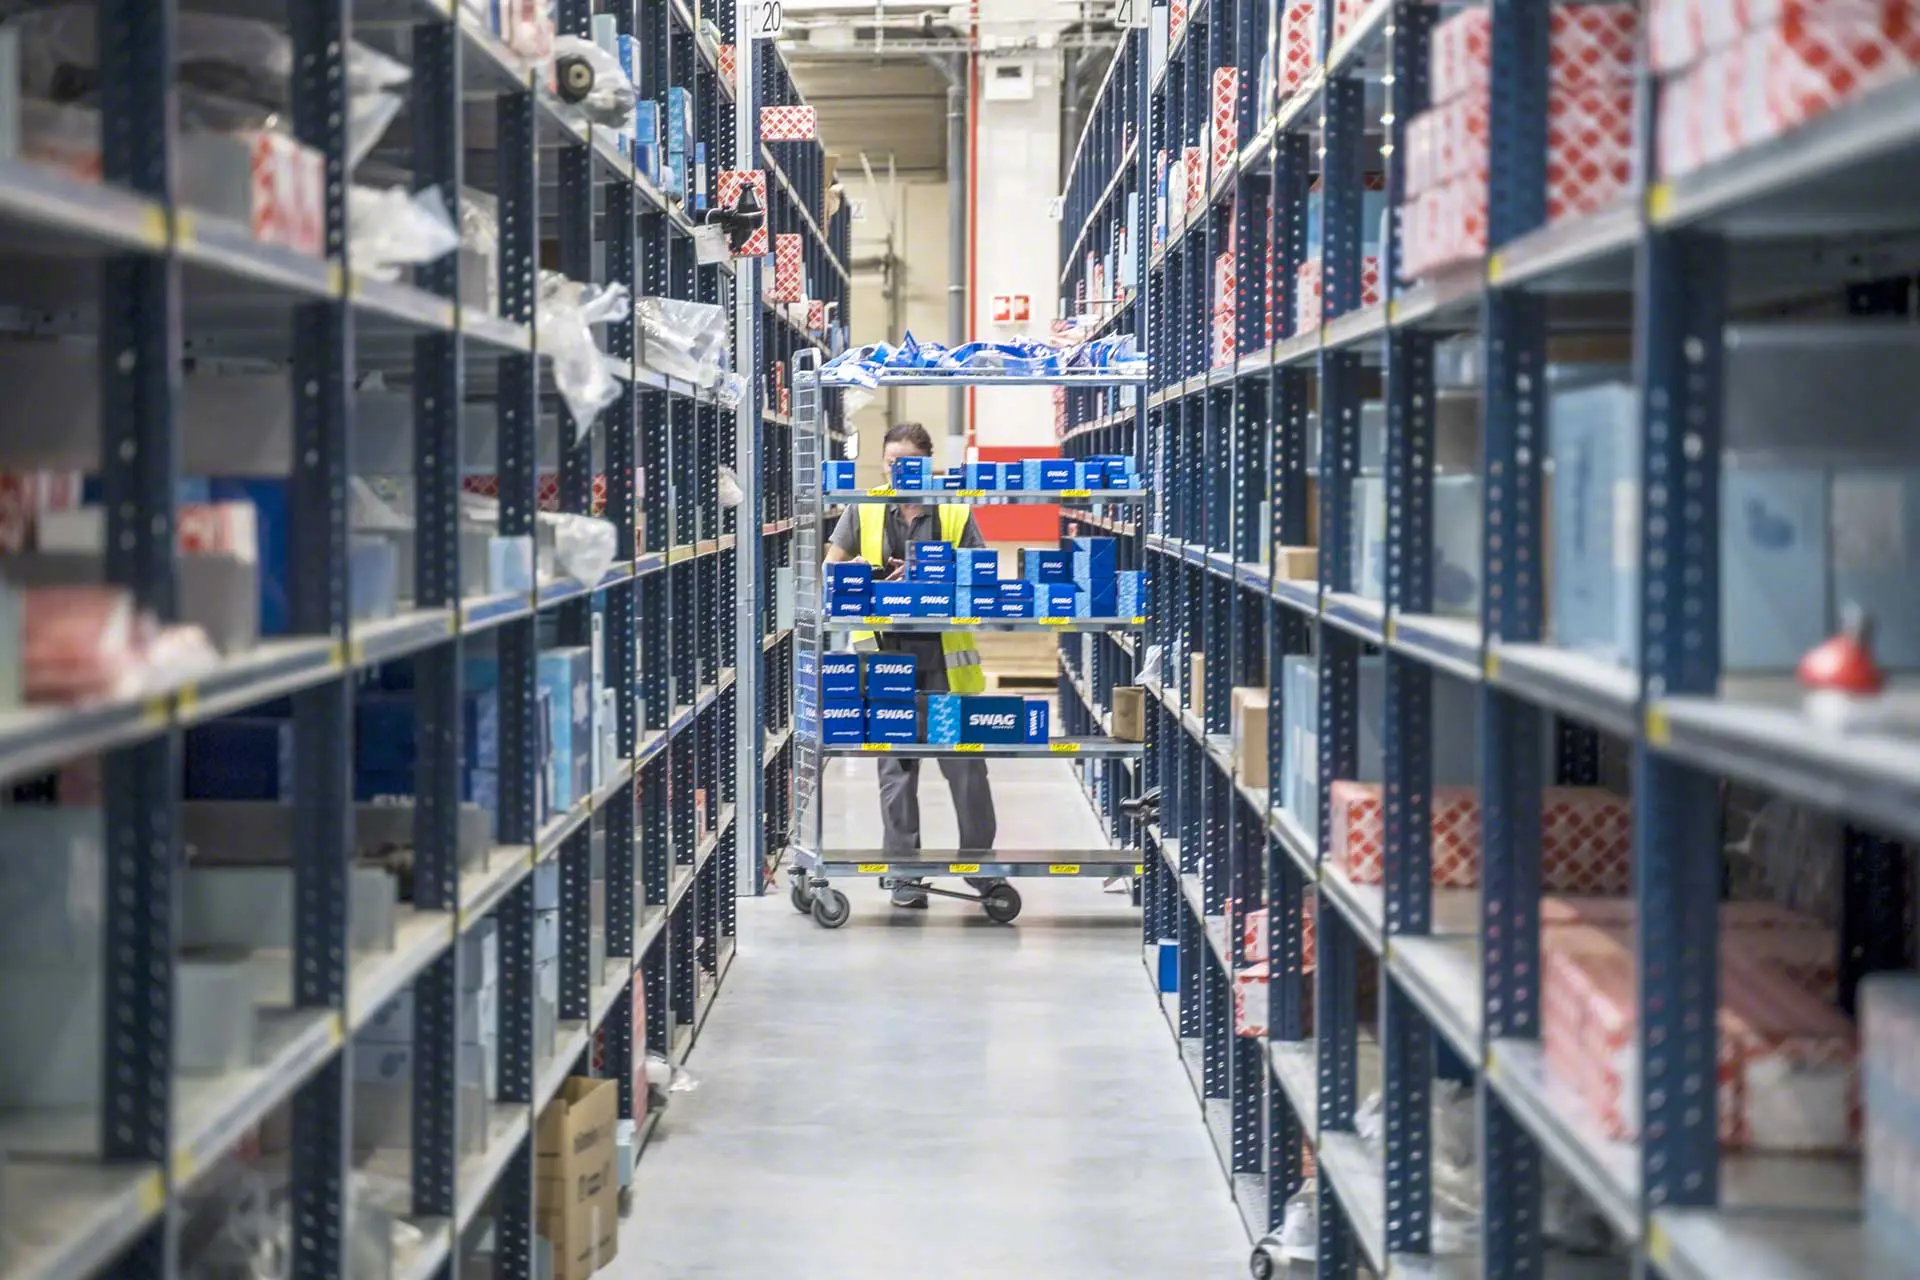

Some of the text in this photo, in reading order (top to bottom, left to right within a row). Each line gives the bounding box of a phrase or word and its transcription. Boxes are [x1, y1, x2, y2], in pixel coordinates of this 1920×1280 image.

[762, 1, 781, 32] 20
[924, 565, 946, 573] SWAG
[882, 596, 912, 605] SWAG
[920, 596, 950, 604] SWAG
[874, 664, 914, 674] SWAG
[823, 708, 861, 718] SWAG
[876, 709, 915, 719] SWAG
[969, 713, 1018, 726] SWAG
[1029, 709, 1038, 736] SWAG
